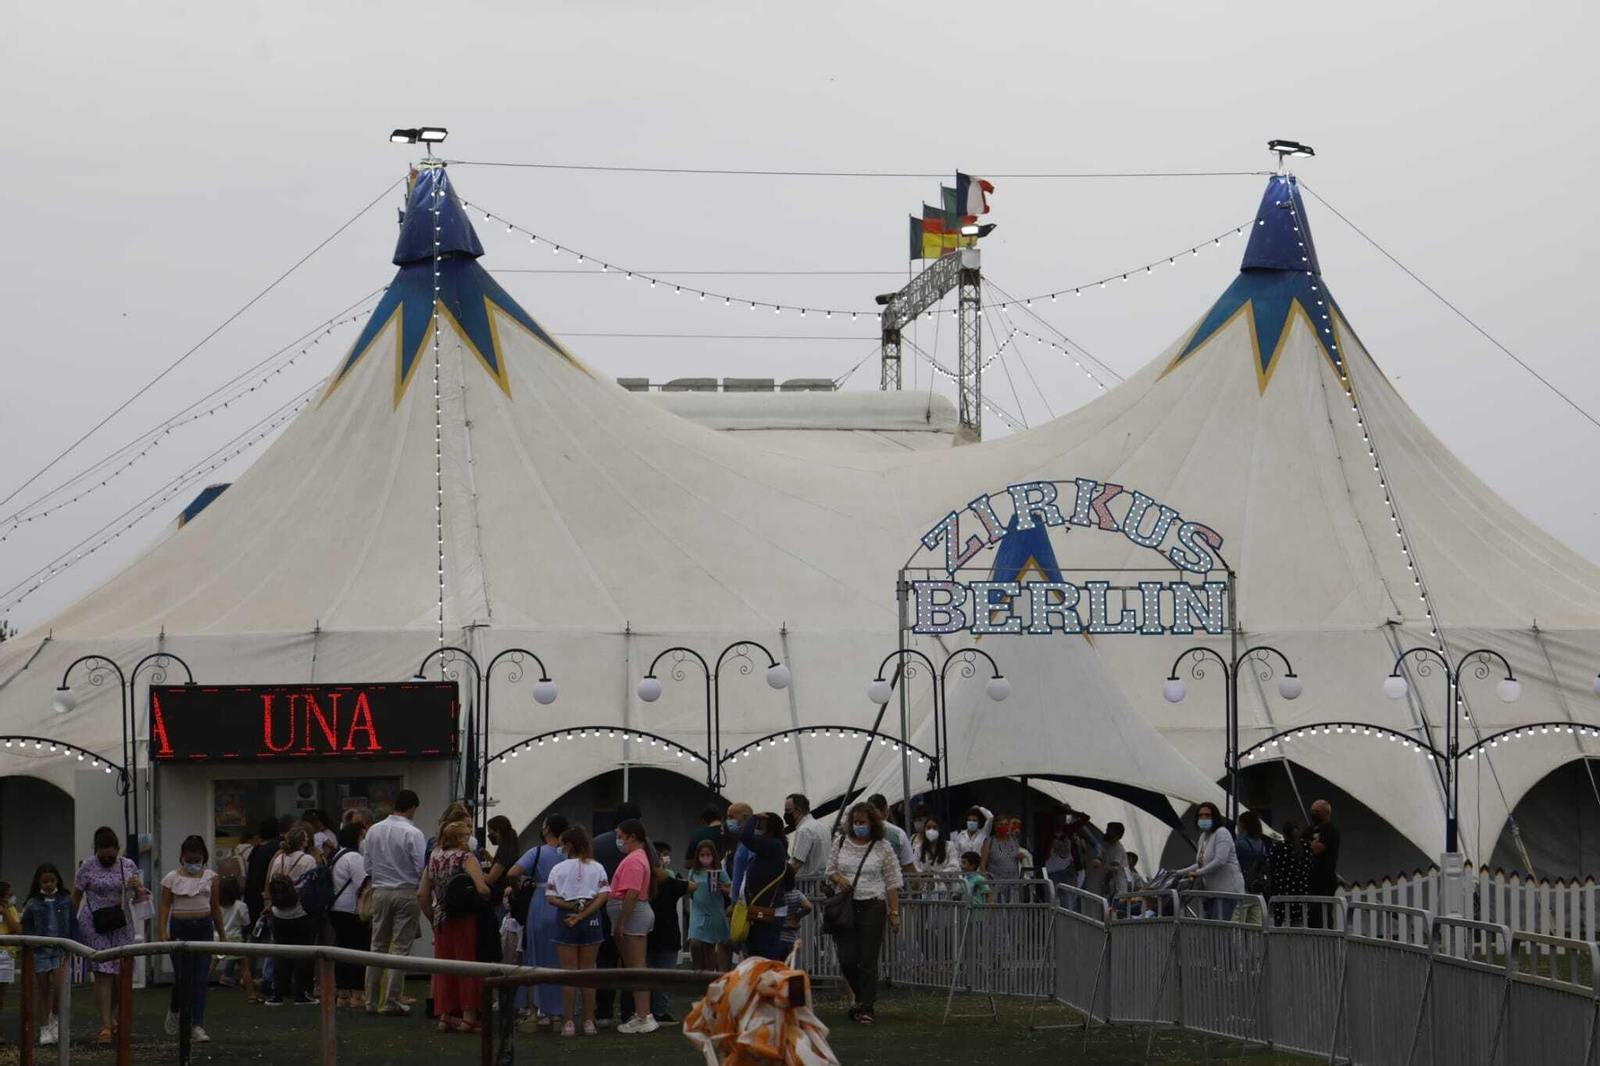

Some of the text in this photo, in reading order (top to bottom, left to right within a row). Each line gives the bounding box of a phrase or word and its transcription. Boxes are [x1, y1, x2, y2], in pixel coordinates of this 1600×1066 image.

[921, 477, 1224, 575] ZIRKUS
[912, 581, 1227, 635] BERLIN
[260, 691, 382, 751] UNA
